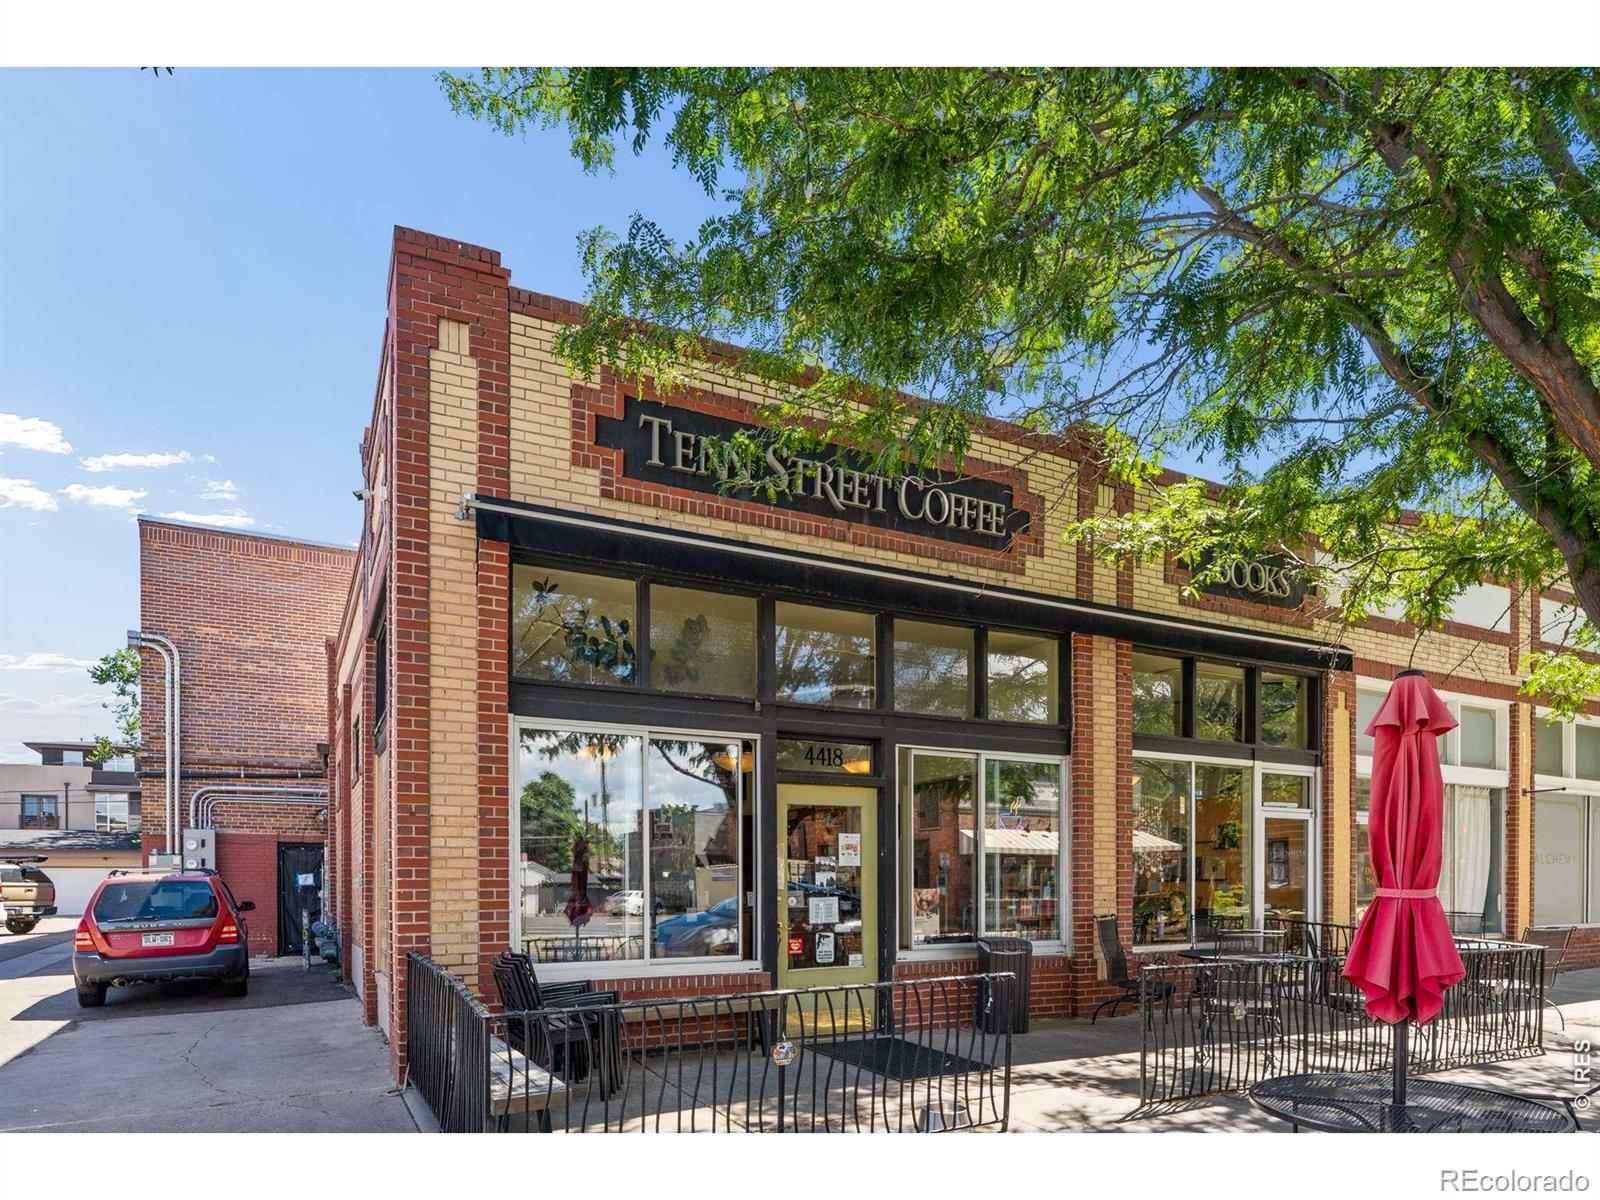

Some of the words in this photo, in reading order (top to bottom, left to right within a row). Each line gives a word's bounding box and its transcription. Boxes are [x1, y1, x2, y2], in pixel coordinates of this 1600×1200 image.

[765, 443, 892, 511] STREET
[898, 475, 1007, 537] COFFEE
[804, 746, 843, 767] 4418
